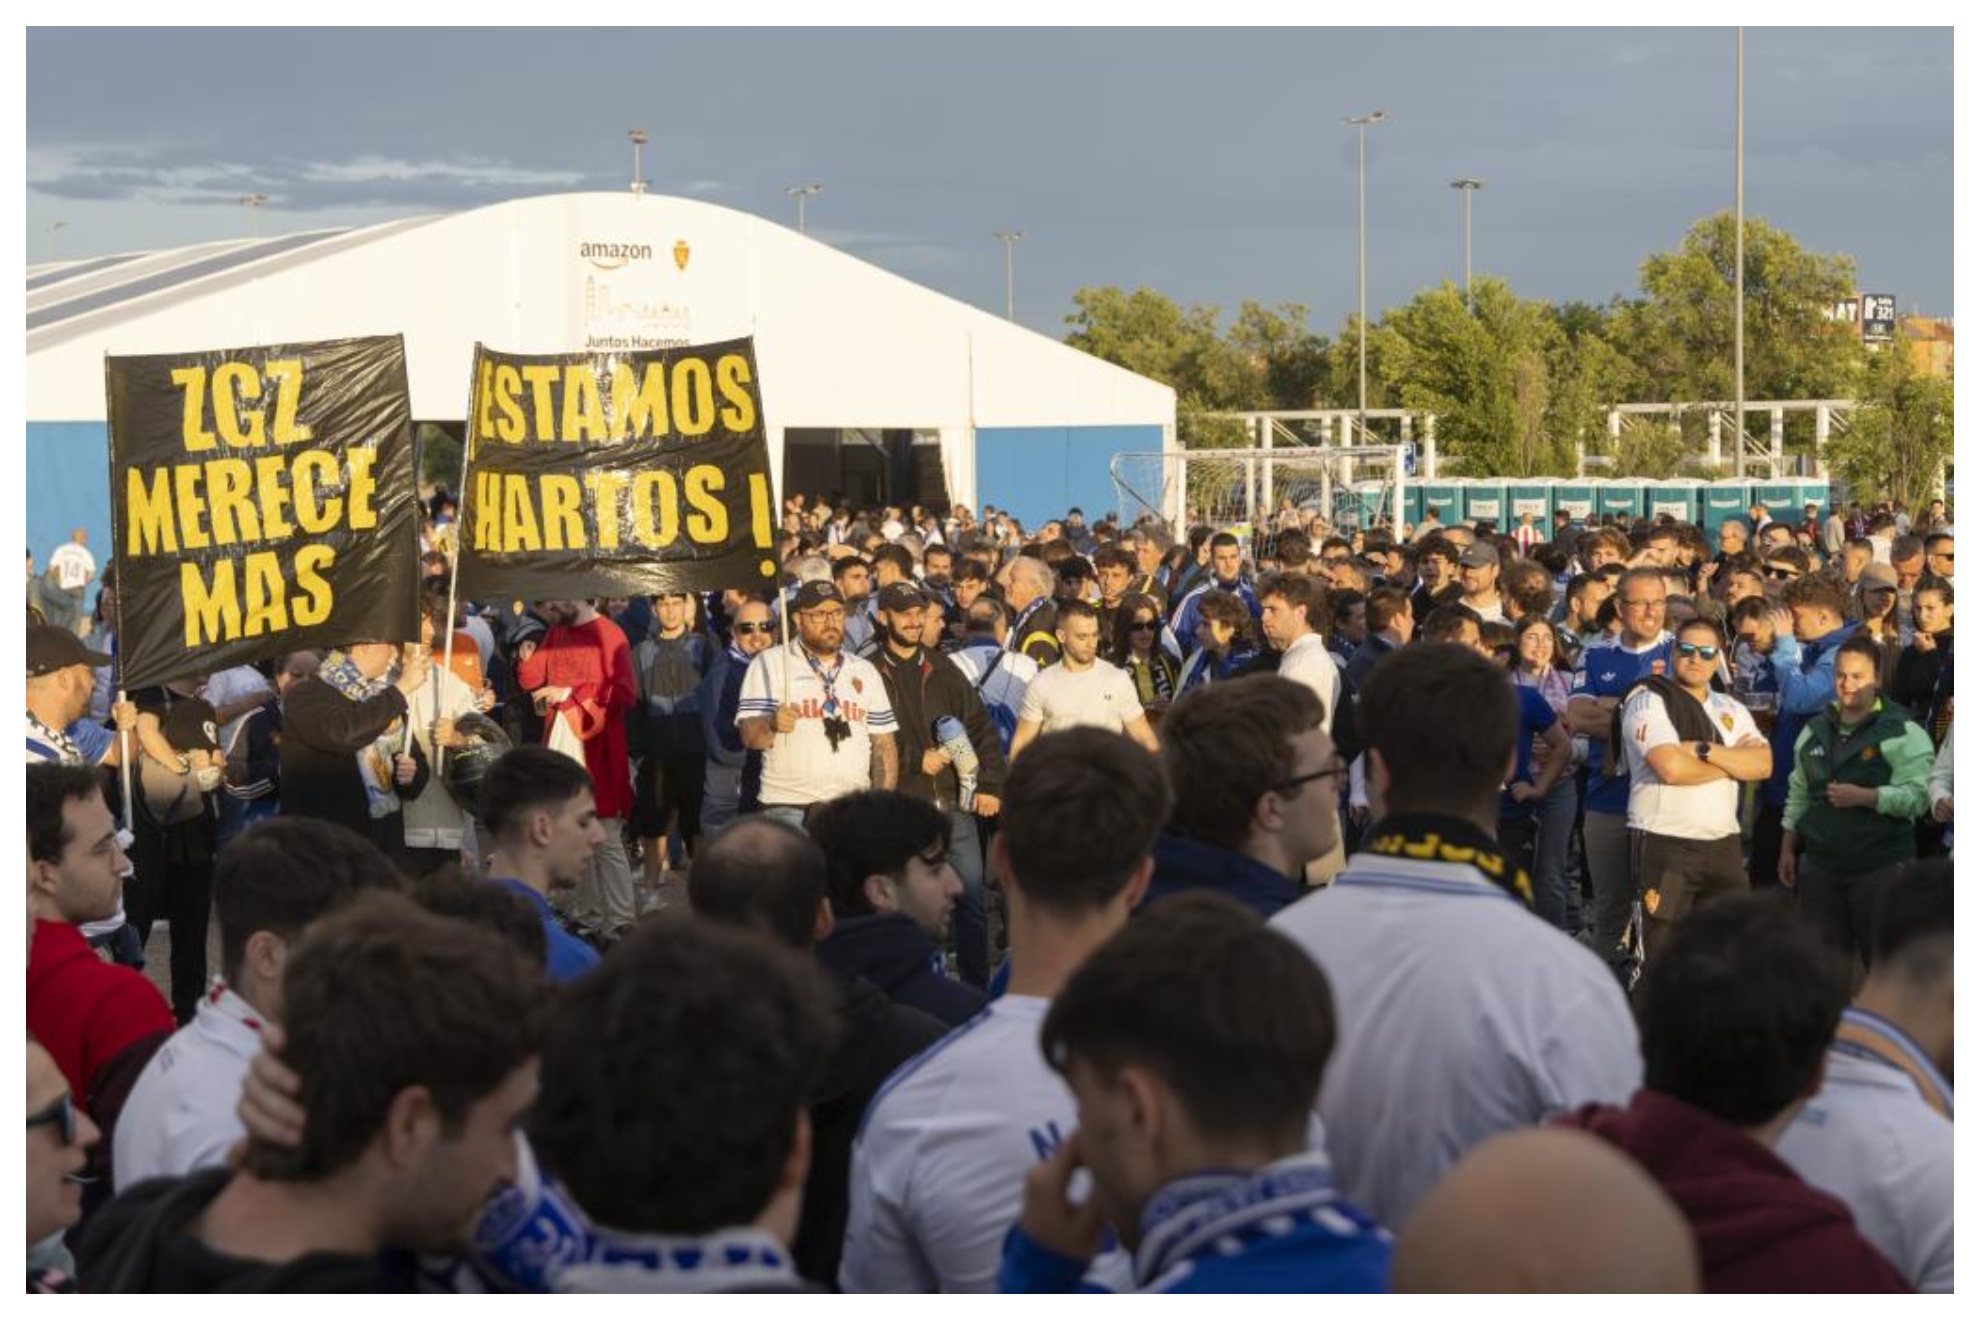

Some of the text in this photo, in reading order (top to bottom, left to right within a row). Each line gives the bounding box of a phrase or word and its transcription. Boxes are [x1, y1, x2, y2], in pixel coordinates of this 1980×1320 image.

[580, 242, 652, 259] amazon
[585, 335, 690, 348] Juntos Hacemos
[171, 360, 313, 451] ZGZ
[127, 446, 378, 556] MERECE
[180, 543, 337, 648] MAS
